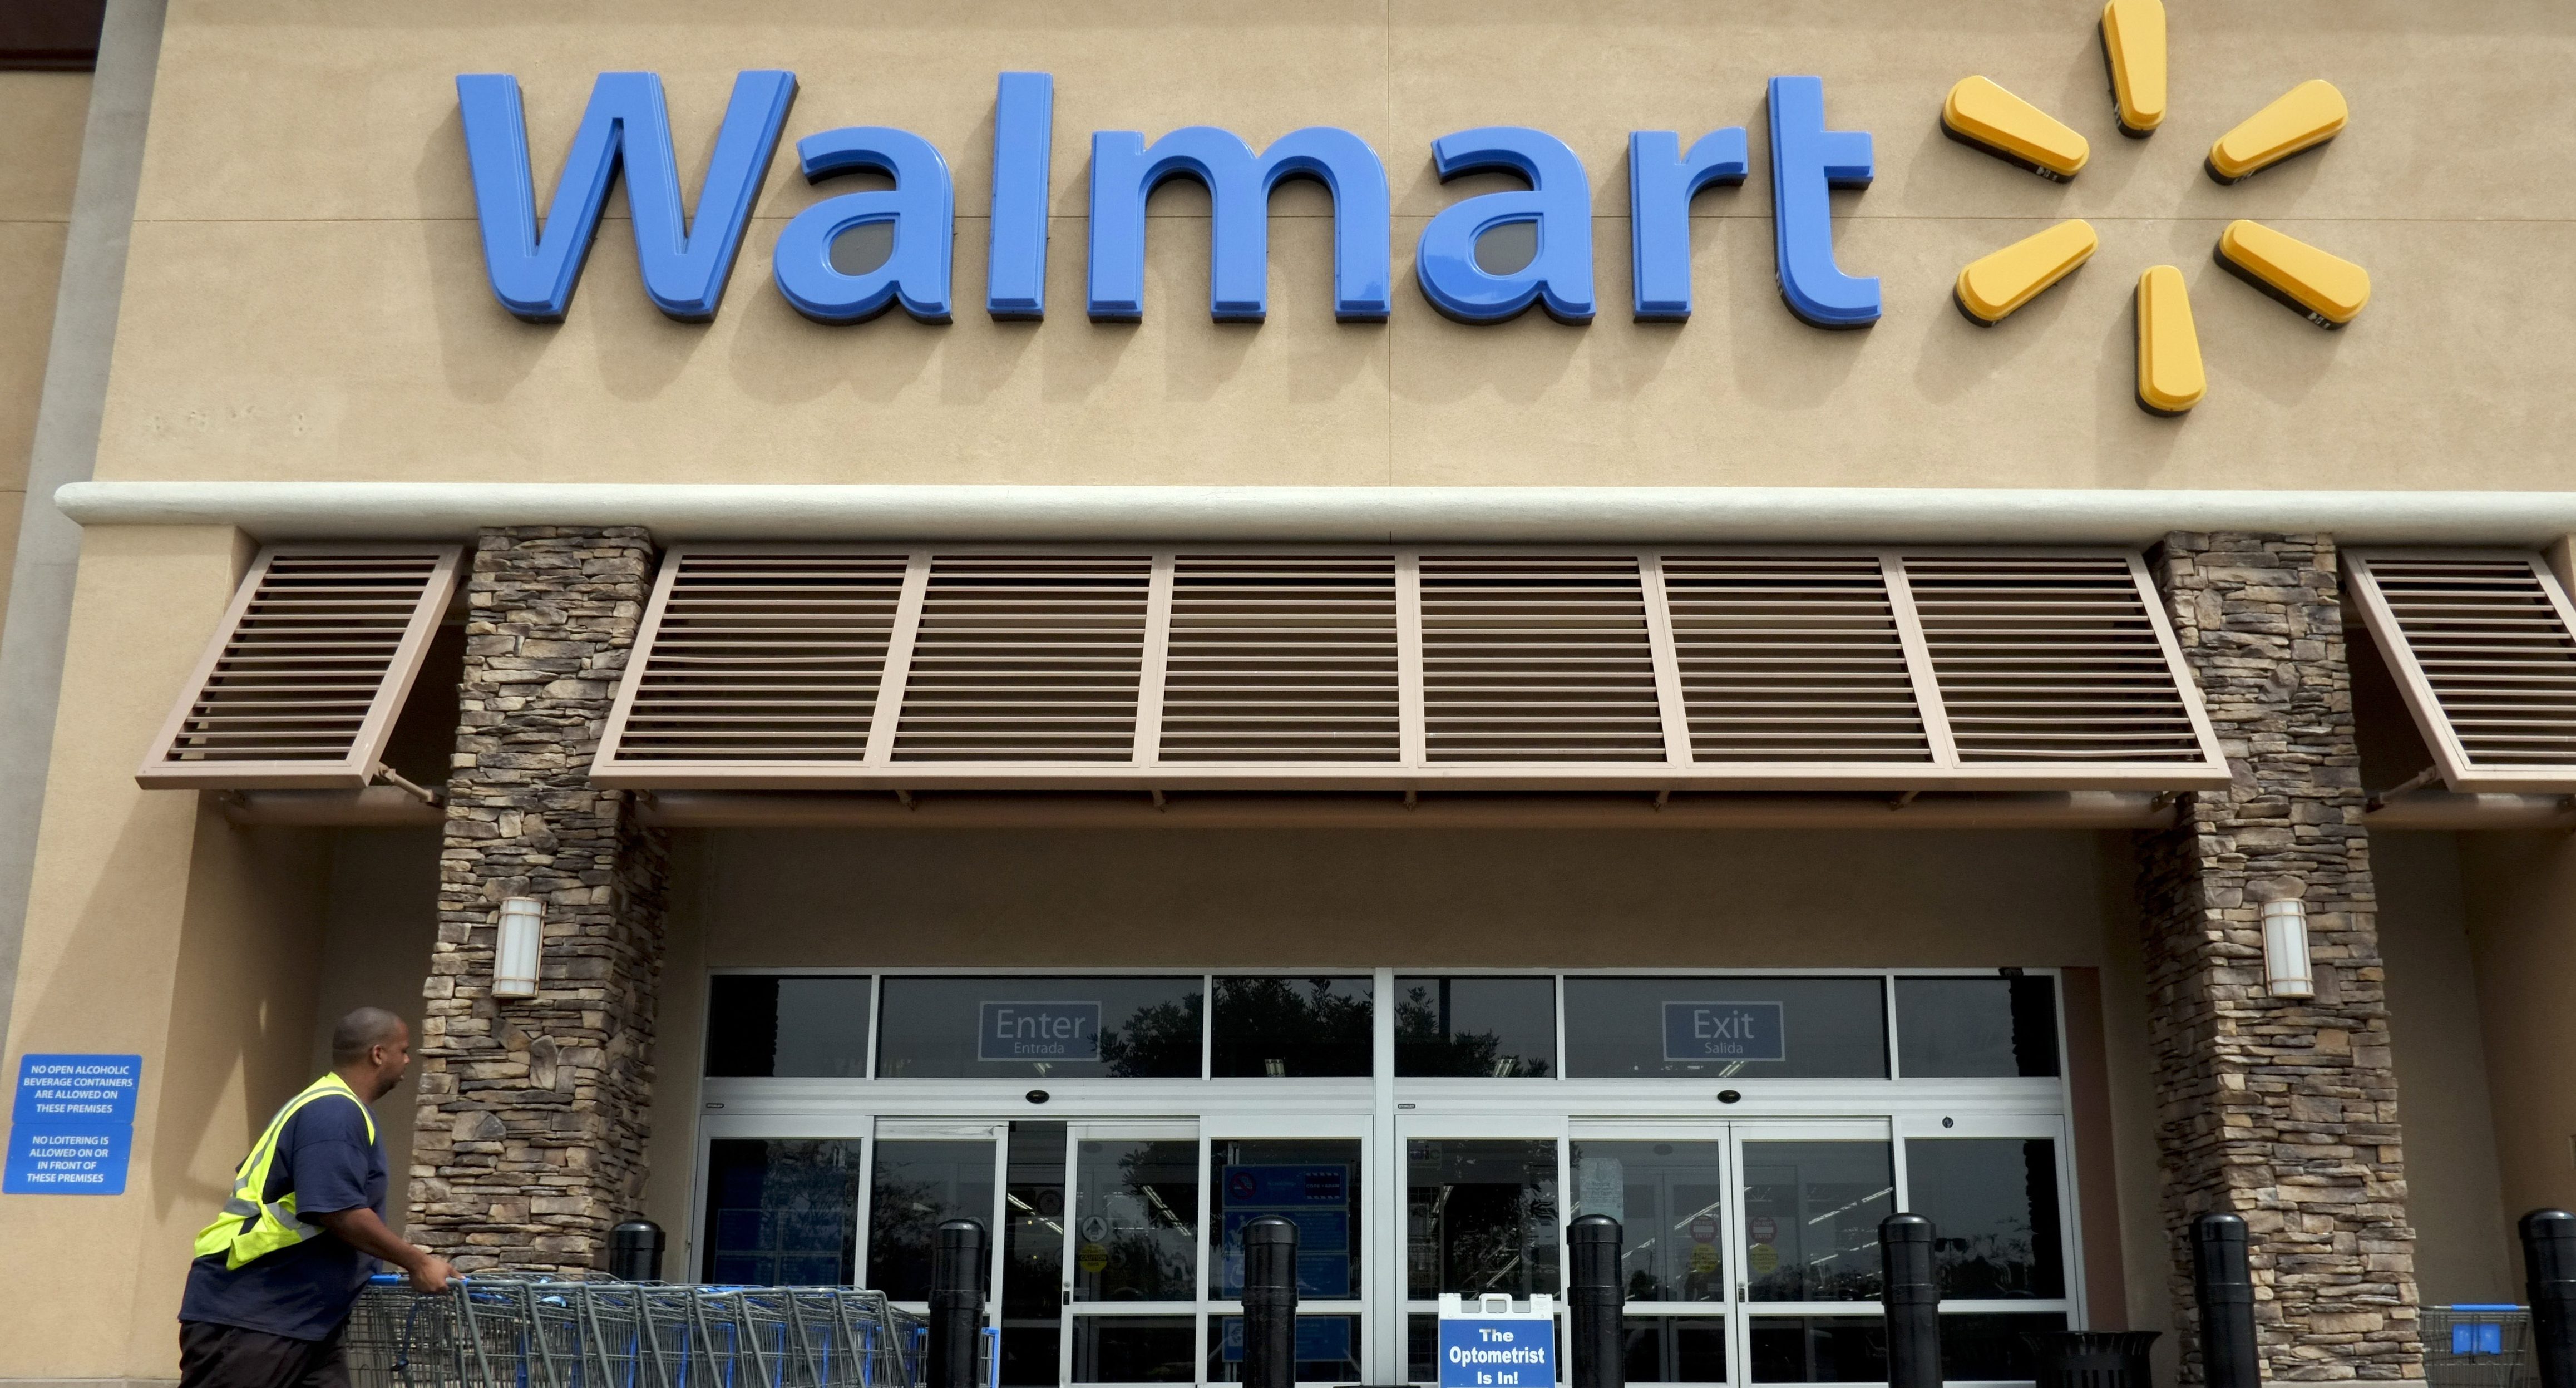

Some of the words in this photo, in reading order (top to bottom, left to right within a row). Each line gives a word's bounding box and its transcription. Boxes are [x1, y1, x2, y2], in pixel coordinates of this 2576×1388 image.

[457, 71, 1881, 329] Walmart
[996, 1009, 1086, 1039] Enter
[1694, 1009, 1754, 1039] Exit
[1014, 1042, 1064, 1054] Entrada
[1705, 1042, 1743, 1054] Salida
[48, 1066, 73, 1074] OPEN
[76, 1066, 129, 1075] ALCOHOLIC
[24, 1078, 72, 1086] BEVERAGE
[74, 1078, 132, 1087] CONTAINERS
[55, 1090, 101, 1099] ALLOWED
[103, 1091, 118, 1099] ON
[37, 1104, 65, 1113] THESE
[67, 1104, 112, 1113] PREMISES
[33, 1136, 47, 1144] NO
[50, 1136, 98, 1145] LOITERING
[101, 1137, 108, 1145] IS
[29, 1149, 76, 1157] ALLOWED
[77, 1149, 92, 1157] ON
[95, 1149, 108, 1157] OR
[38, 1161, 48, 1169] IN
[50, 1161, 81, 1170] FRONT
[83, 1162, 97, 1170] OF
[27, 1174, 56, 1182] THESE
[58, 1174, 104, 1183] PREMISES
[1479, 1328, 1514, 1342] The
[1449, 1346, 1545, 1367] Optometrist
[1477, 1371, 1492, 1385] Is
[1498, 1371, 1518, 1385] In!
